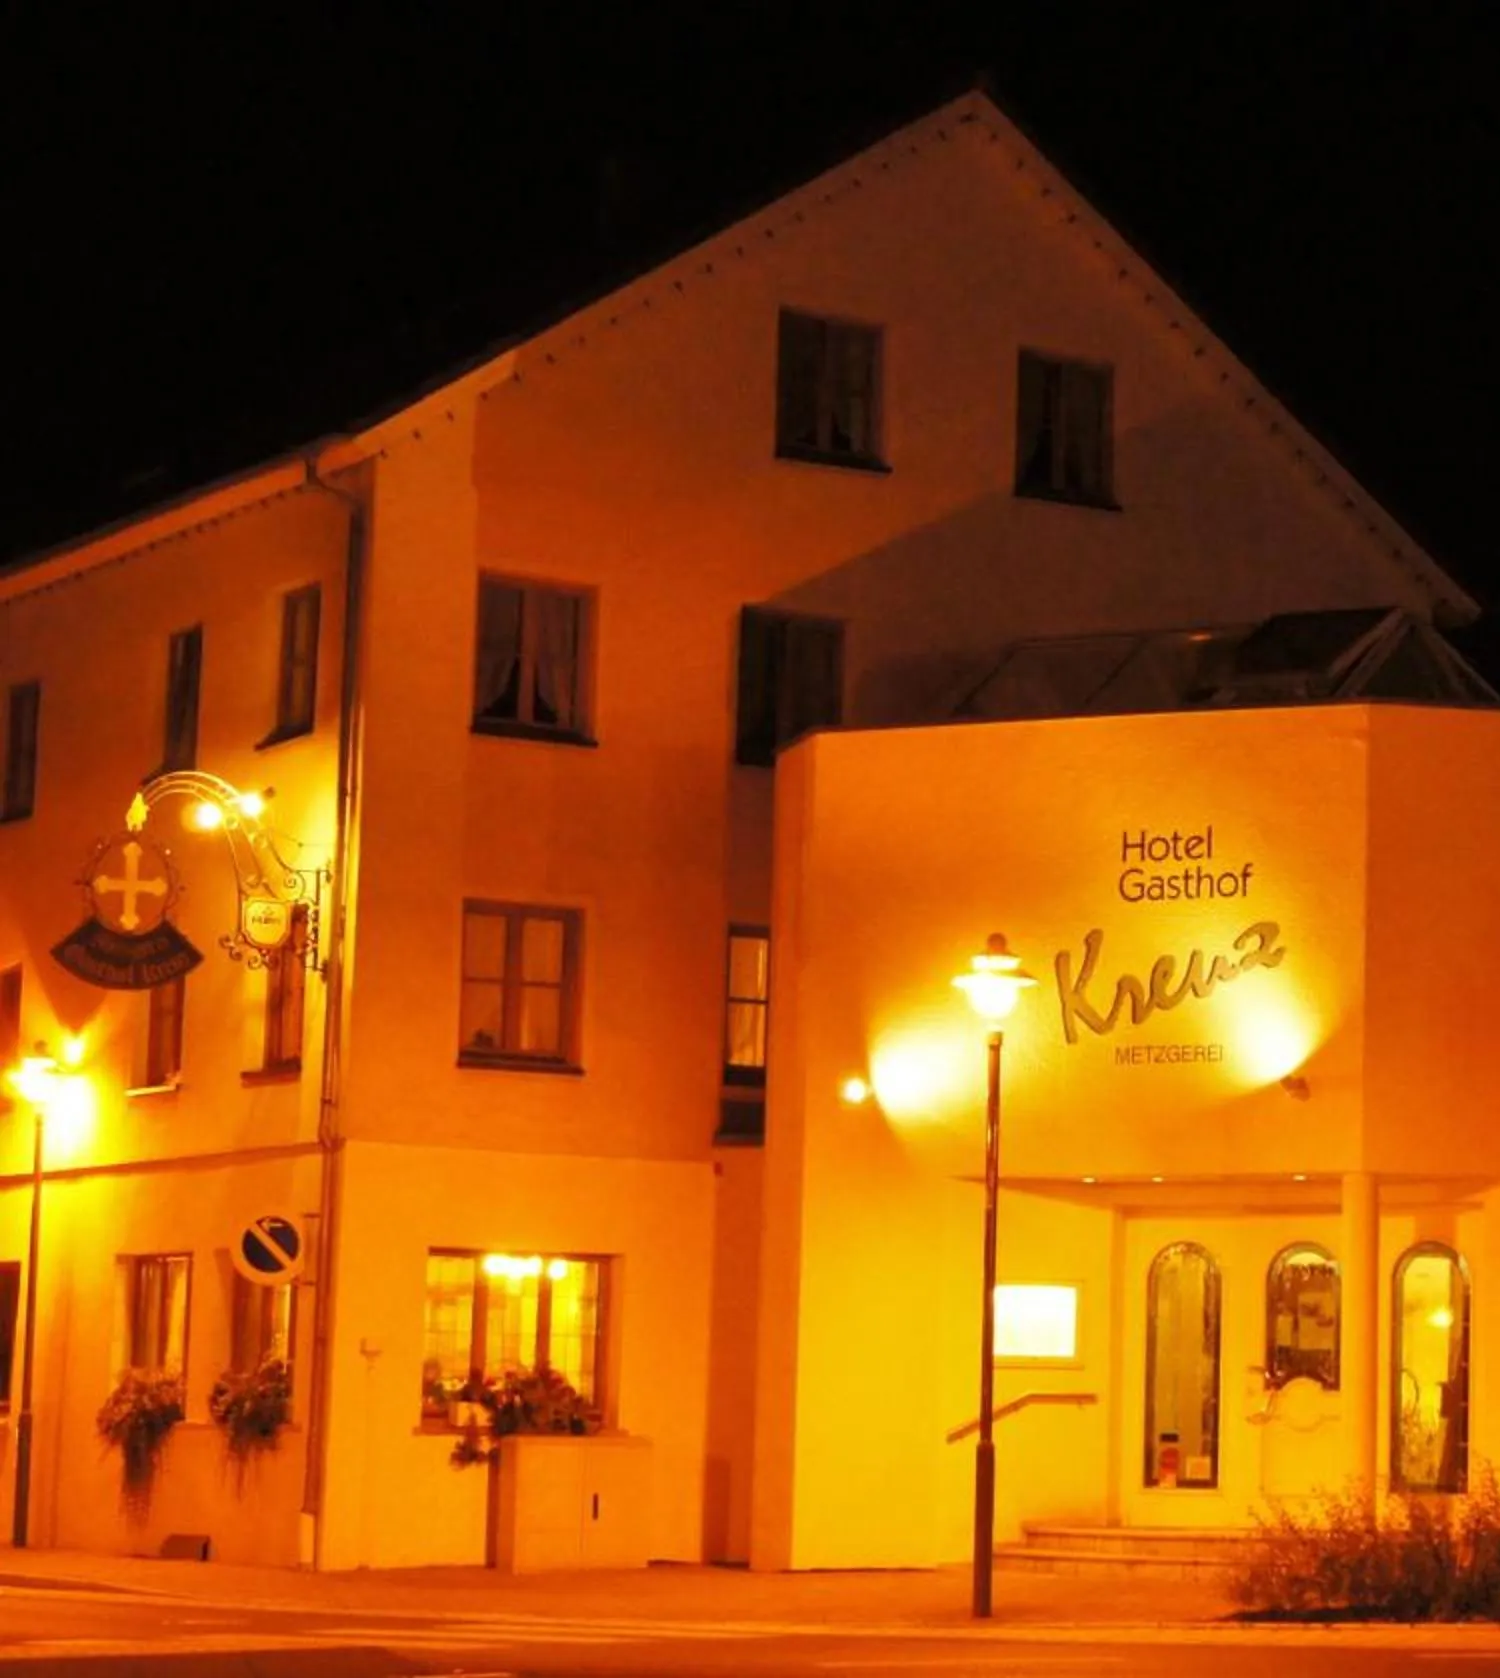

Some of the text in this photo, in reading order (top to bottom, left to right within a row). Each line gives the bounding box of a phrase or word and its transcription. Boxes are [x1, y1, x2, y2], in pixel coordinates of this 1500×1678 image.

[1121, 825, 1214, 863] Hotel
[1118, 863, 1253, 902] Gasthof
[1055, 921, 1286, 1045] Kreuz
[1114, 1044, 1224, 1066] METZGEREI
